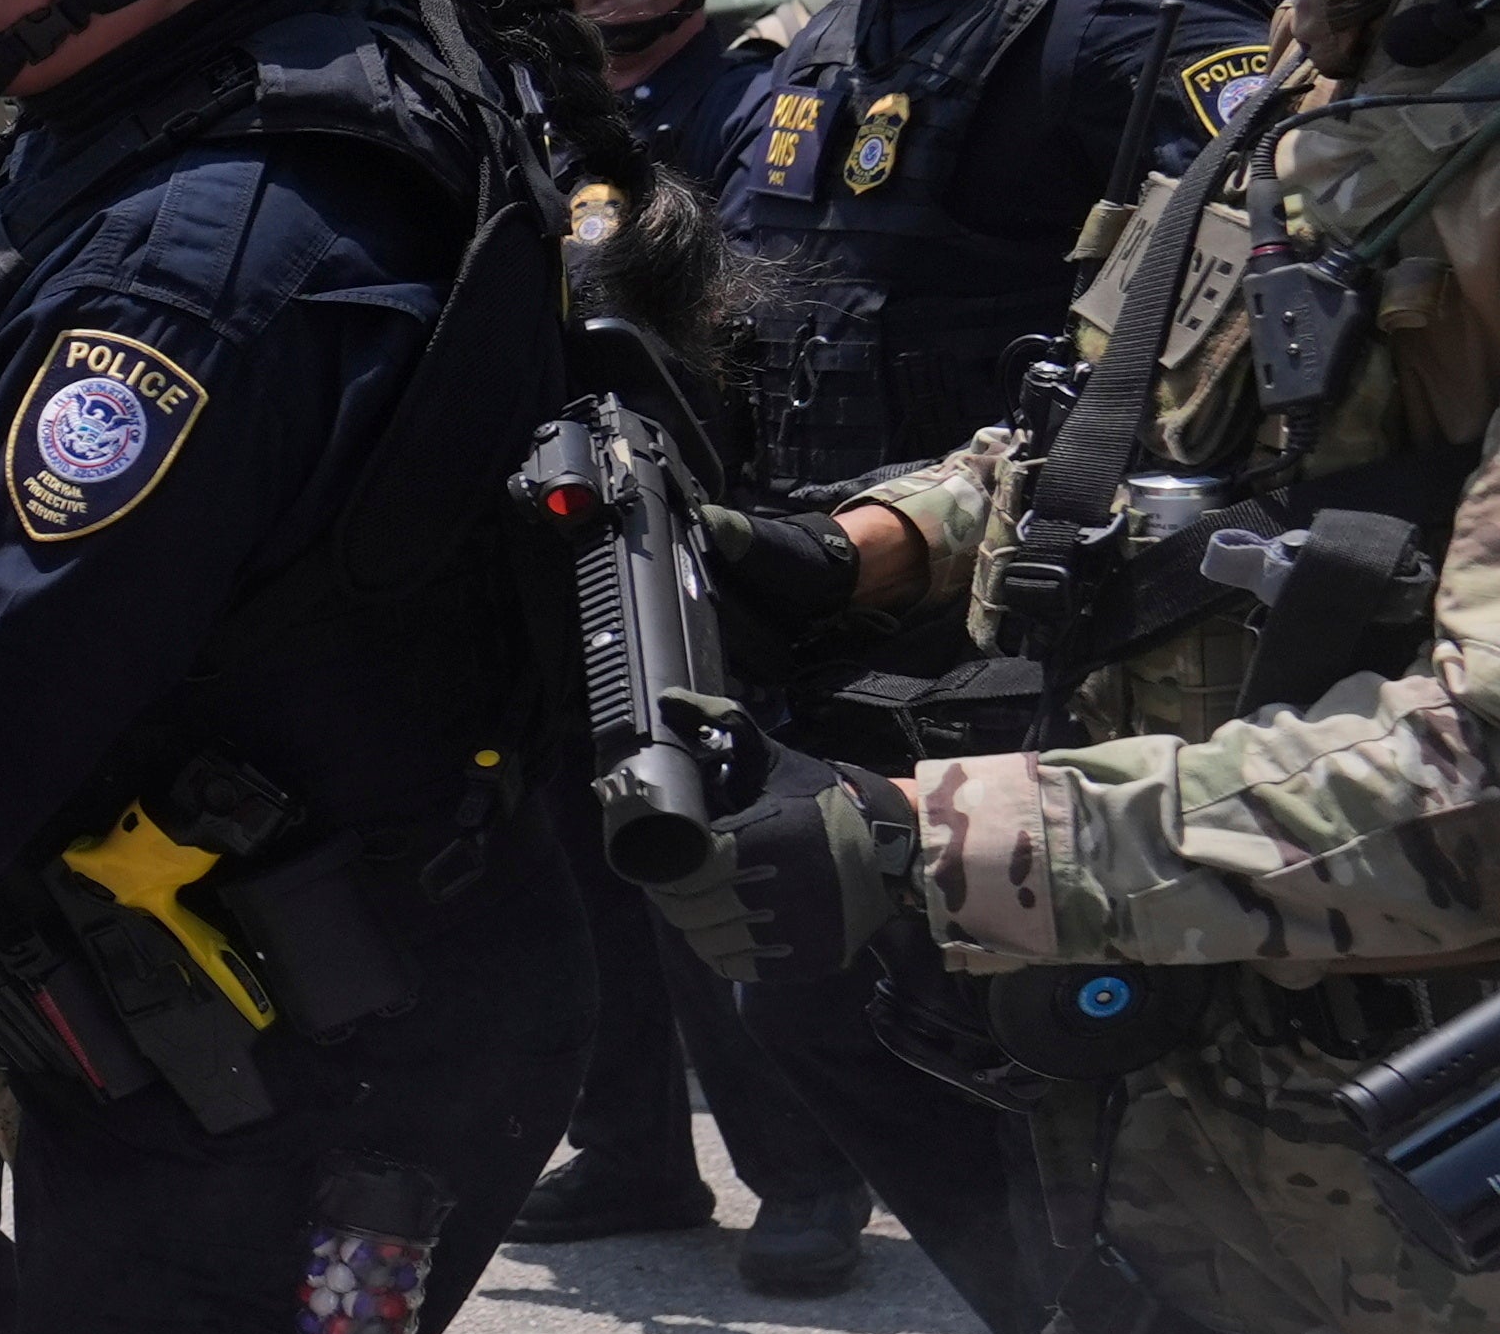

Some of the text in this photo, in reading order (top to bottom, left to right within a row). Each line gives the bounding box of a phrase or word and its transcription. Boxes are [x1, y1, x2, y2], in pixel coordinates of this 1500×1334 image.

[1194, 54, 1268, 94] POLIC
[769, 93, 825, 133] POLICE
[765, 130, 801, 168] DHS
[66, 341, 189, 416] POLICE
[23, 476, 89, 515] PROTECTIVE
[26, 499, 69, 527] SERVICE
